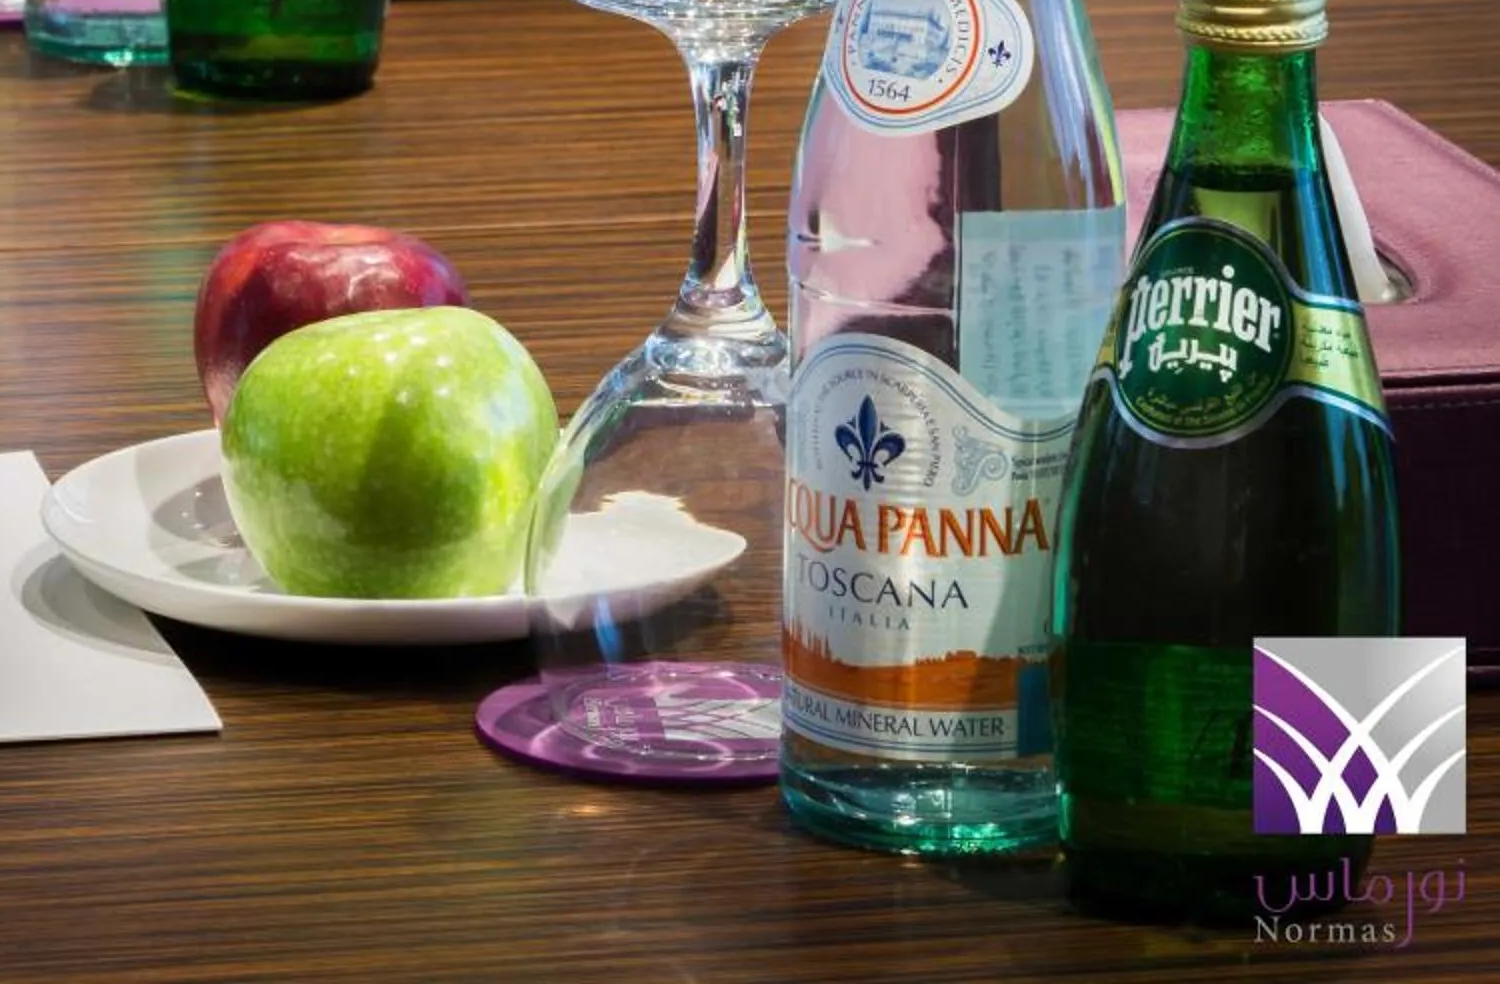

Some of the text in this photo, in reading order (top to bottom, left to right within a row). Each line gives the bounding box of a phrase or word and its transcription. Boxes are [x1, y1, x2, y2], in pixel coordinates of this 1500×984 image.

[868, 78, 911, 102] 1564
[787, 477, 1050, 558] CQUA PANNA
[797, 553, 970, 610] TOSCANA
[828, 606, 911, 631] ITALIA
[835, 706, 926, 736] MINERAL
[930, 716, 1005, 737] WATER
